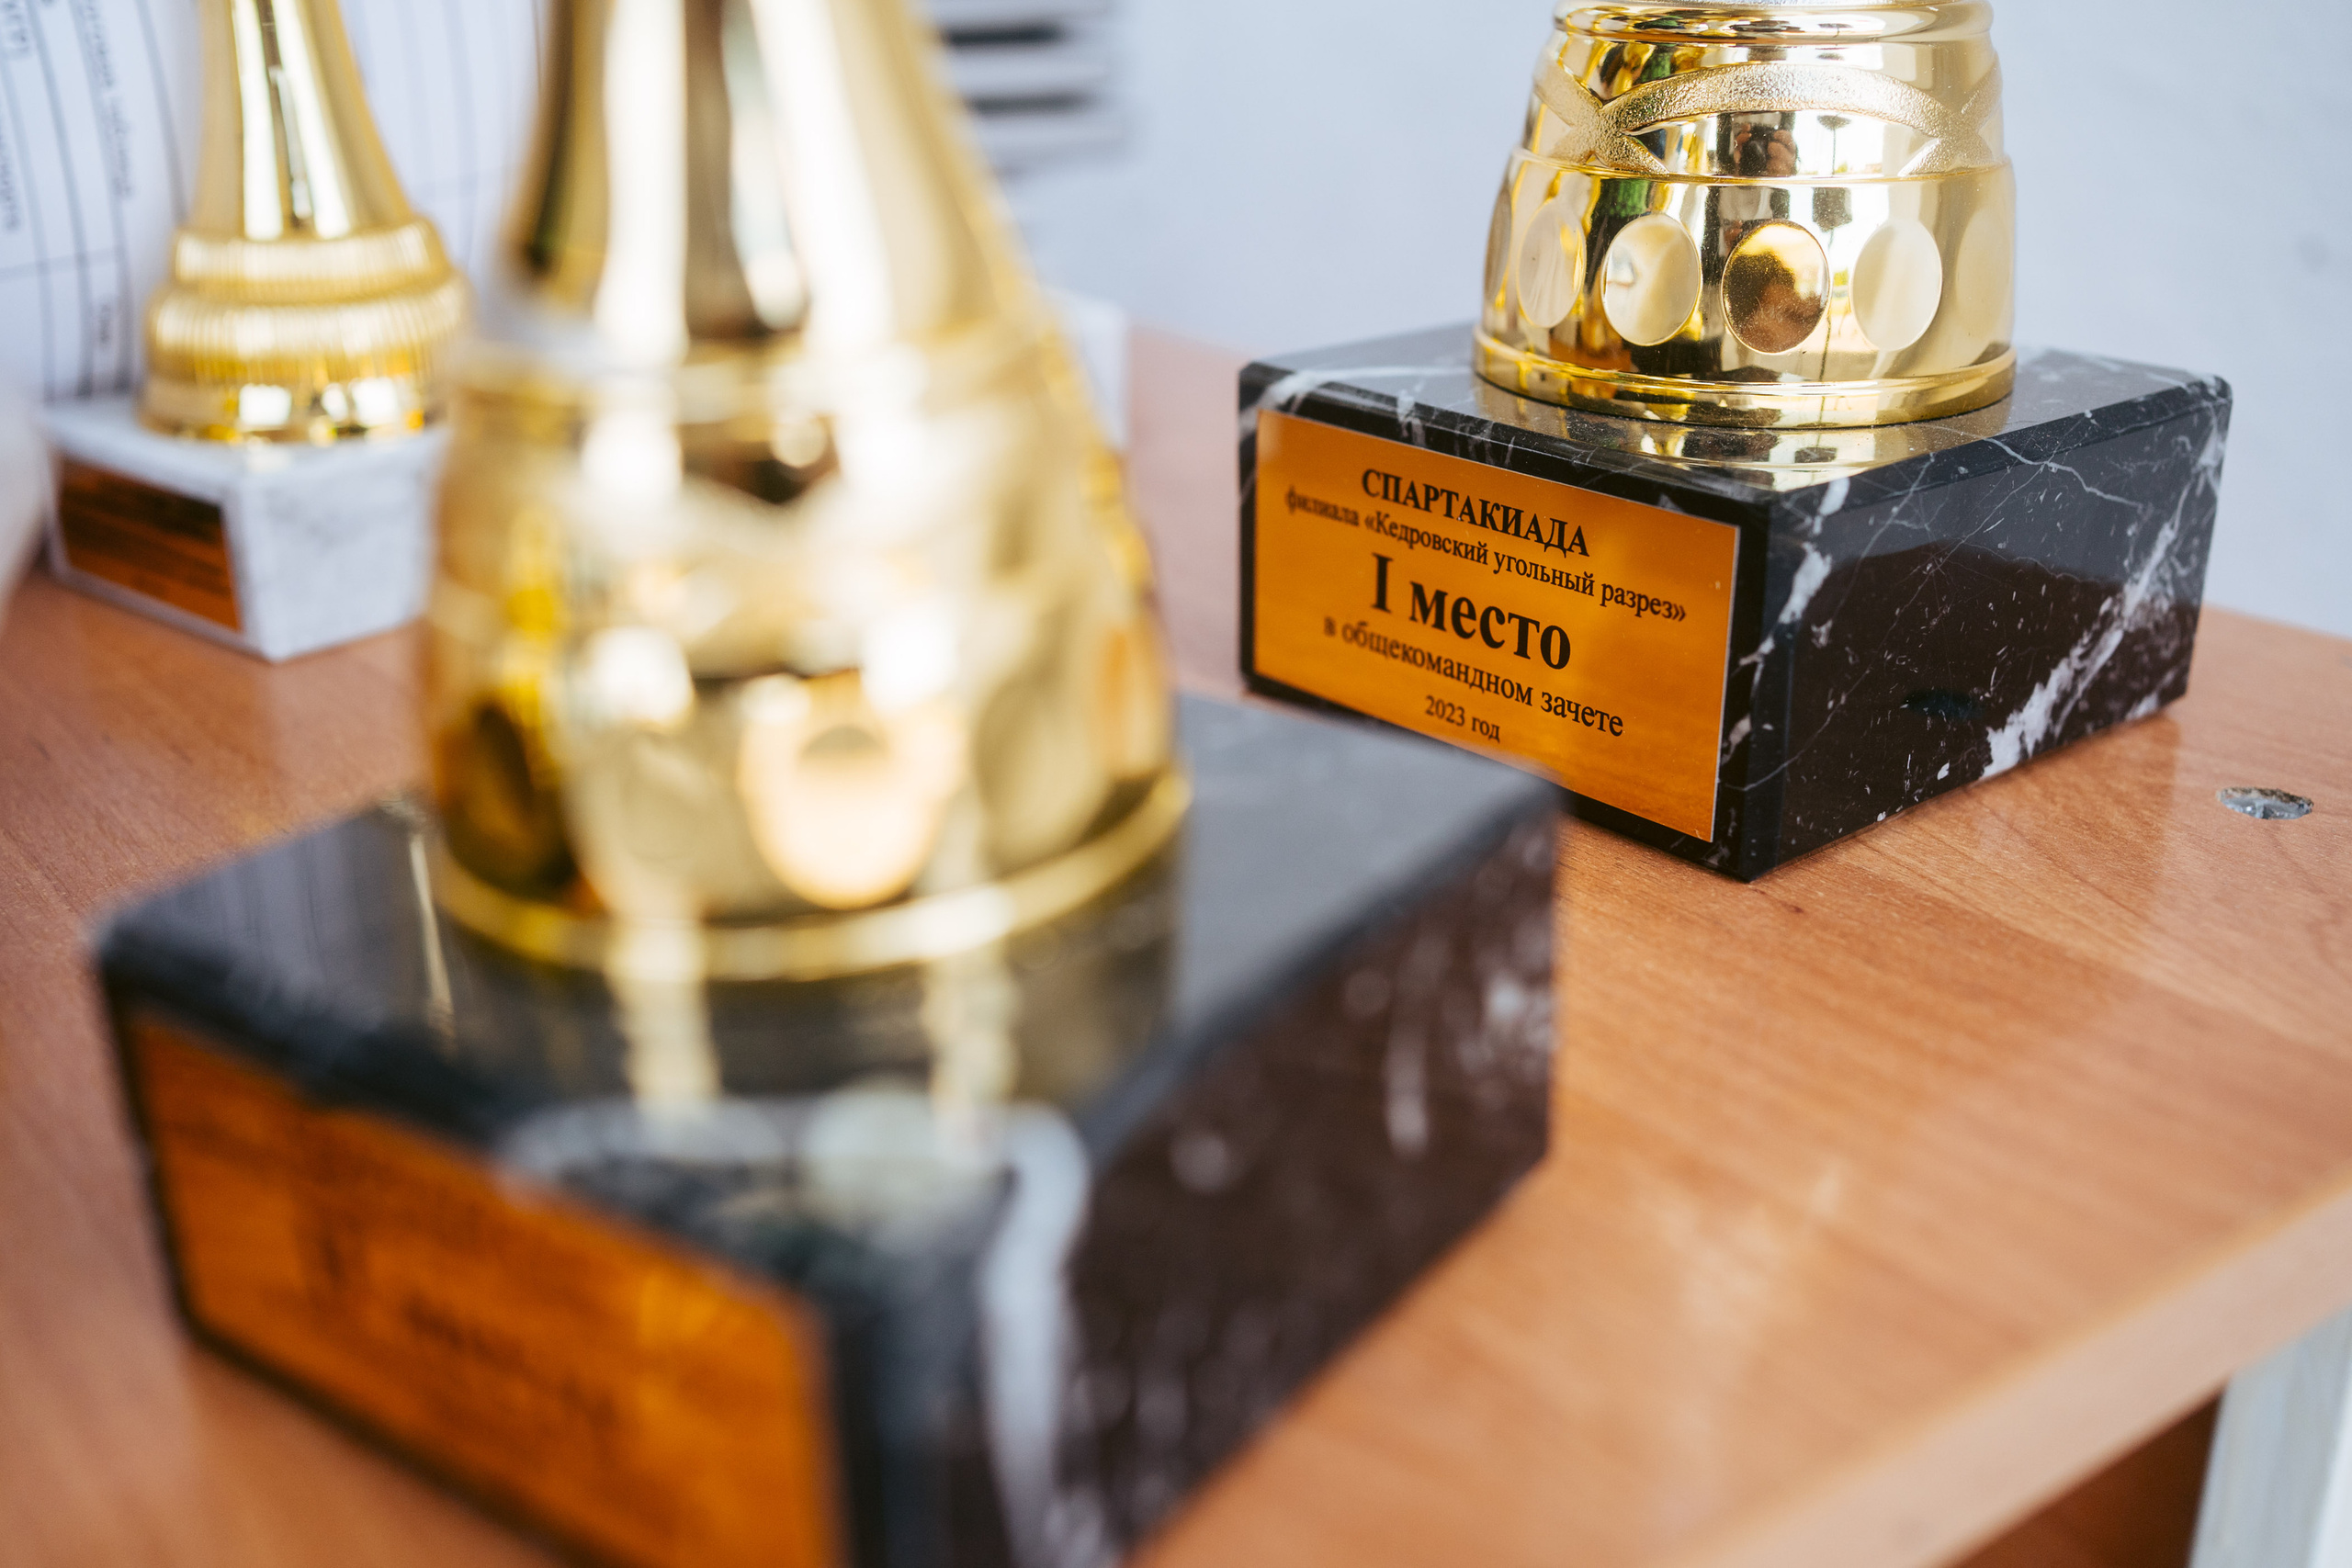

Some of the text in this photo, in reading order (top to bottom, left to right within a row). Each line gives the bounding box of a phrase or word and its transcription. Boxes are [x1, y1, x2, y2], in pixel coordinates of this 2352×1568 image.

[1286, 486, 1687, 622] филиала «Кедровский угольный разрез»
[1362, 468, 1590, 558] СПАРТАКИАДА
[1372, 552, 1571, 670] I место
[1323, 615, 1623, 737] в общекомандном зачете
[1425, 695, 1500, 742] 2023 год
